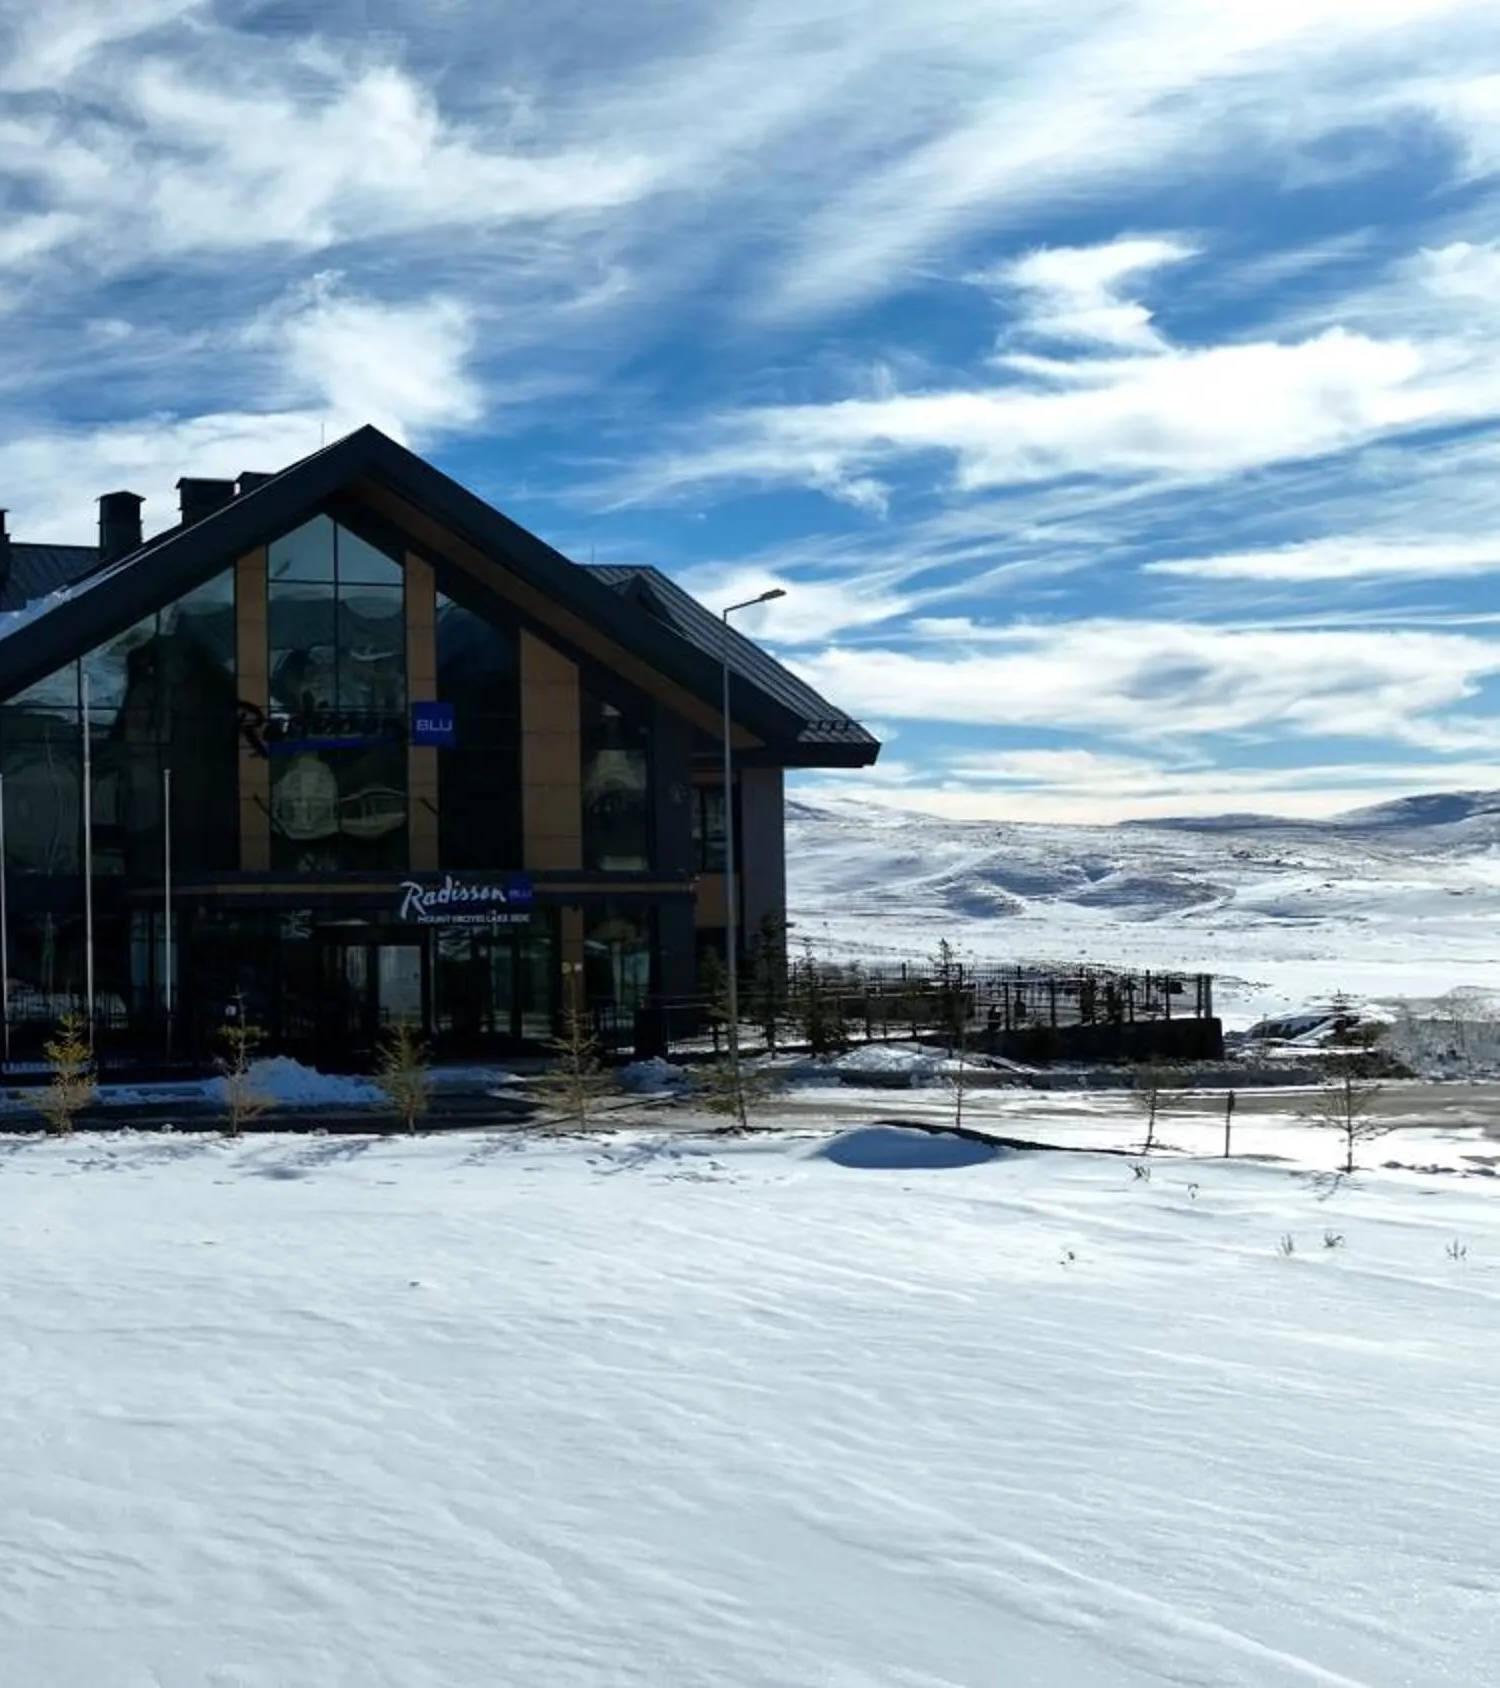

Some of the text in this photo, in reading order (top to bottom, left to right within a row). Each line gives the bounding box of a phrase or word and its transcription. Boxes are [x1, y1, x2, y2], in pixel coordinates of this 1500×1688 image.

[416, 719, 453, 732] BLU
[400, 875, 507, 919] Radisson
[417, 914, 451, 924] MOUNT
